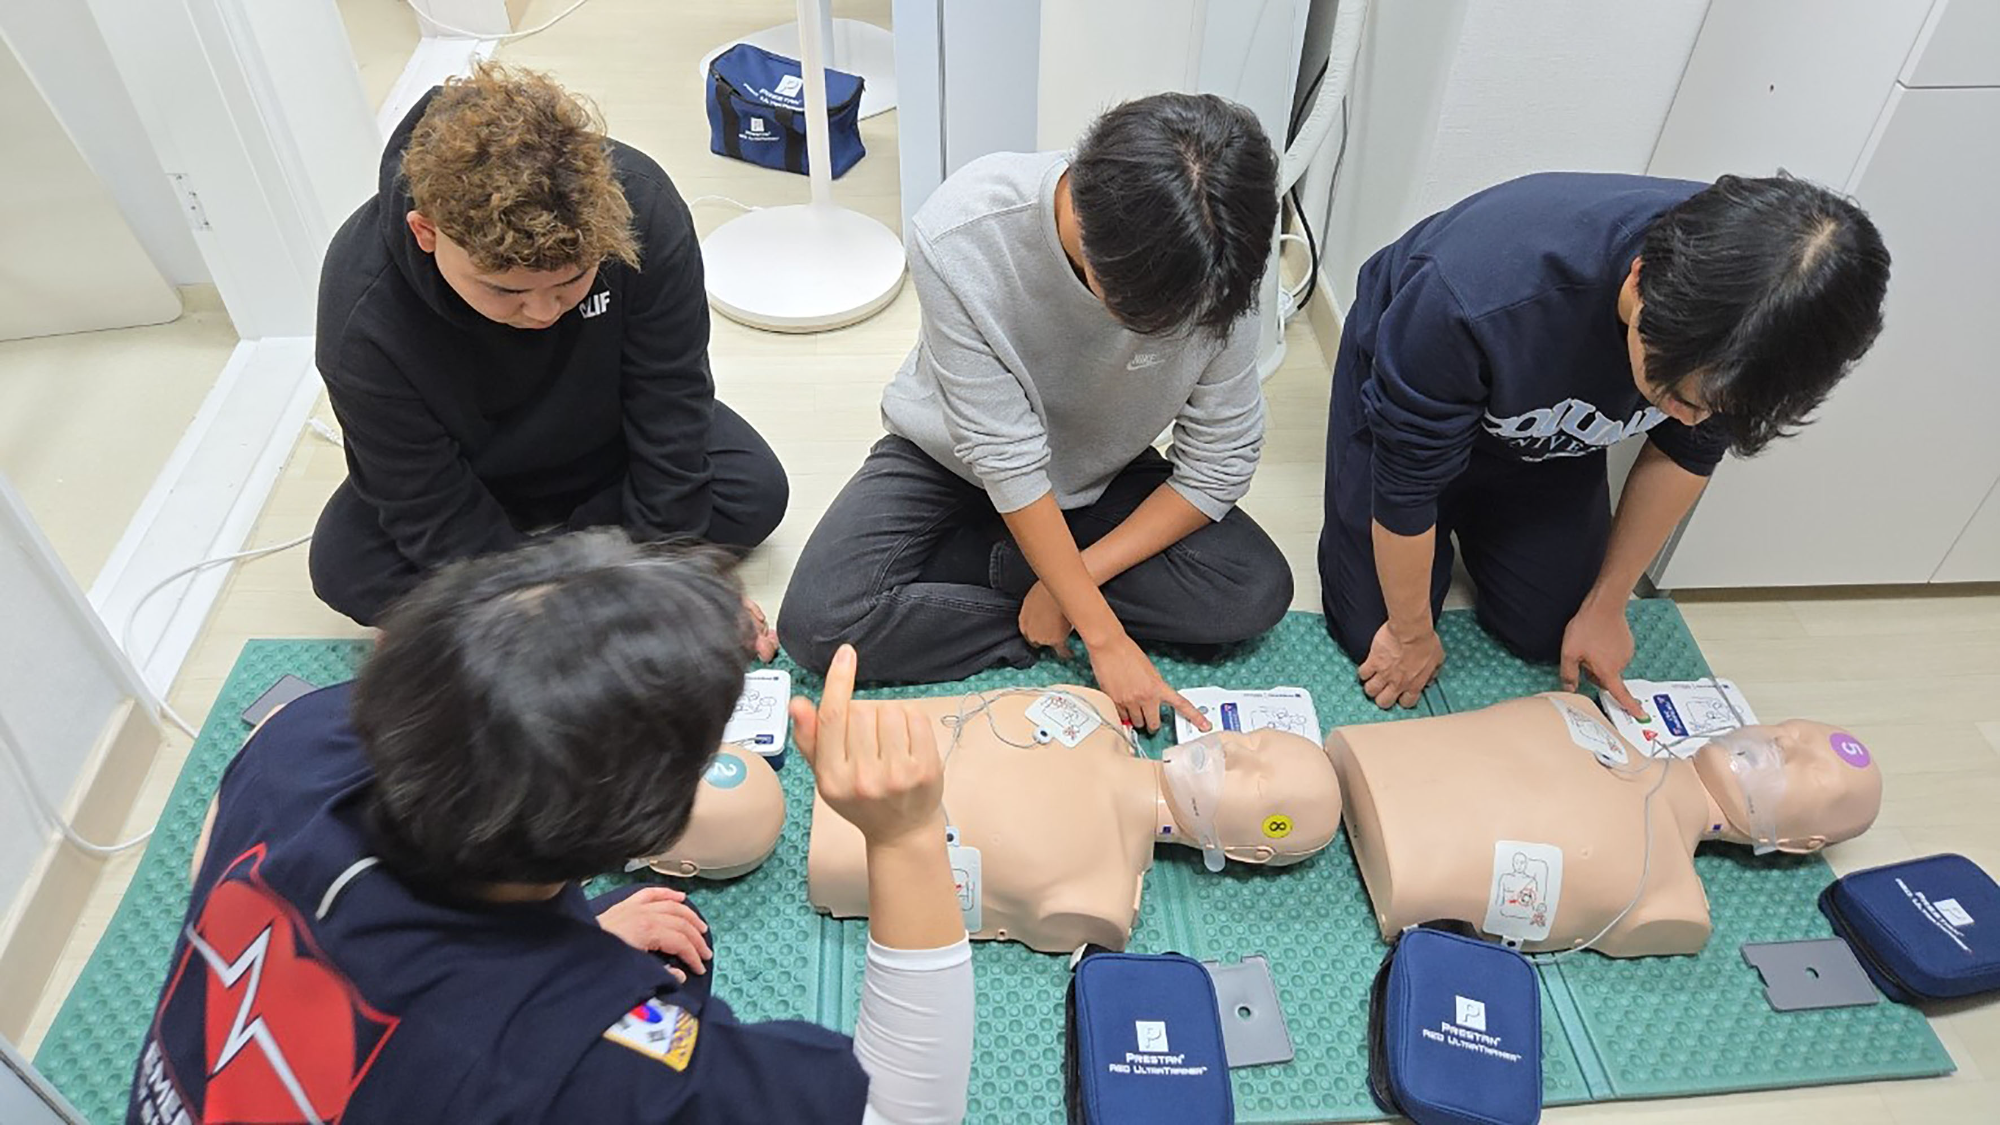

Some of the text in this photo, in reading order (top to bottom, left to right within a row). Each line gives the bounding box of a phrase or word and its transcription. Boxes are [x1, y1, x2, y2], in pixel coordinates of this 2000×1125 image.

[1841, 742, 1864, 755] 5
[713, 761, 737, 776] 2
[1269, 821, 1287, 832] 8
